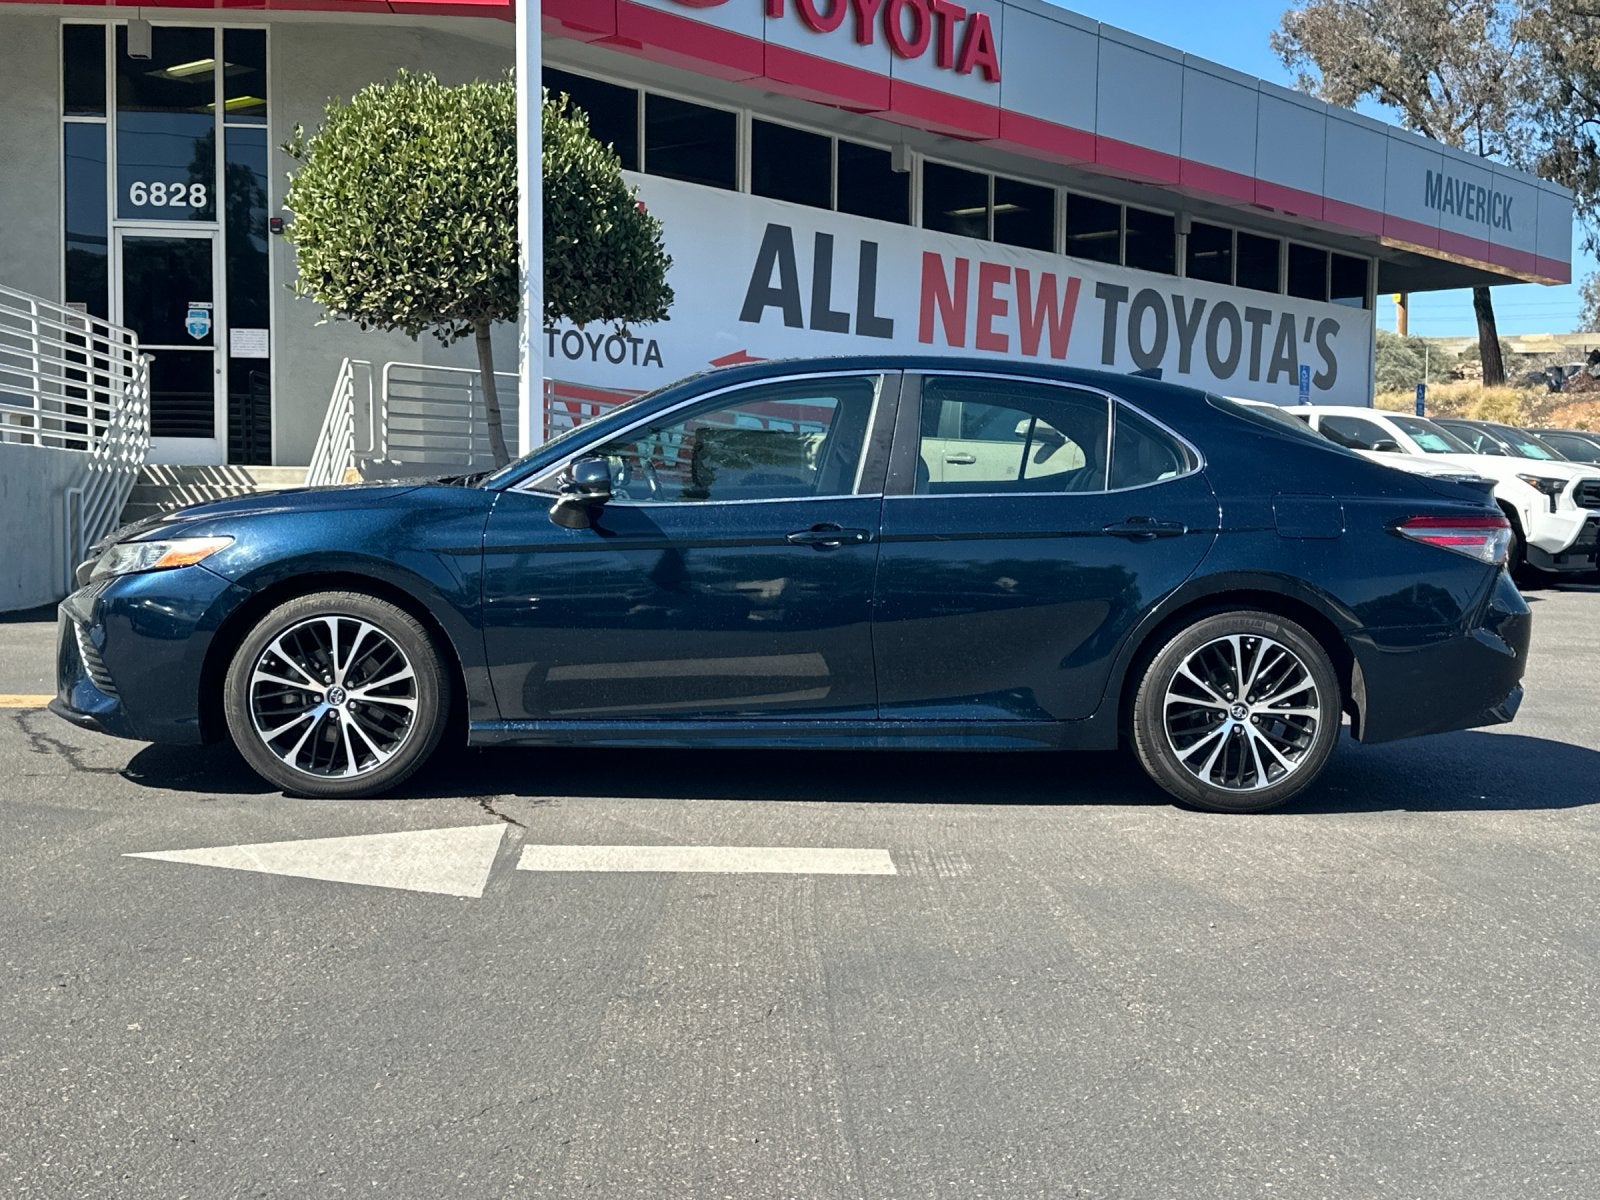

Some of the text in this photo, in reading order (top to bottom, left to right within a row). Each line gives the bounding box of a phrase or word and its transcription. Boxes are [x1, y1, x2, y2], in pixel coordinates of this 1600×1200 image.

[766, 0, 1001, 83] YOTA
[129, 181, 207, 208] 6828
[1424, 169, 1513, 232] MAVERICK
[739, 223, 1340, 390] ALL NEW TOYOTA'S
[543, 327, 664, 368] TOYOTA
